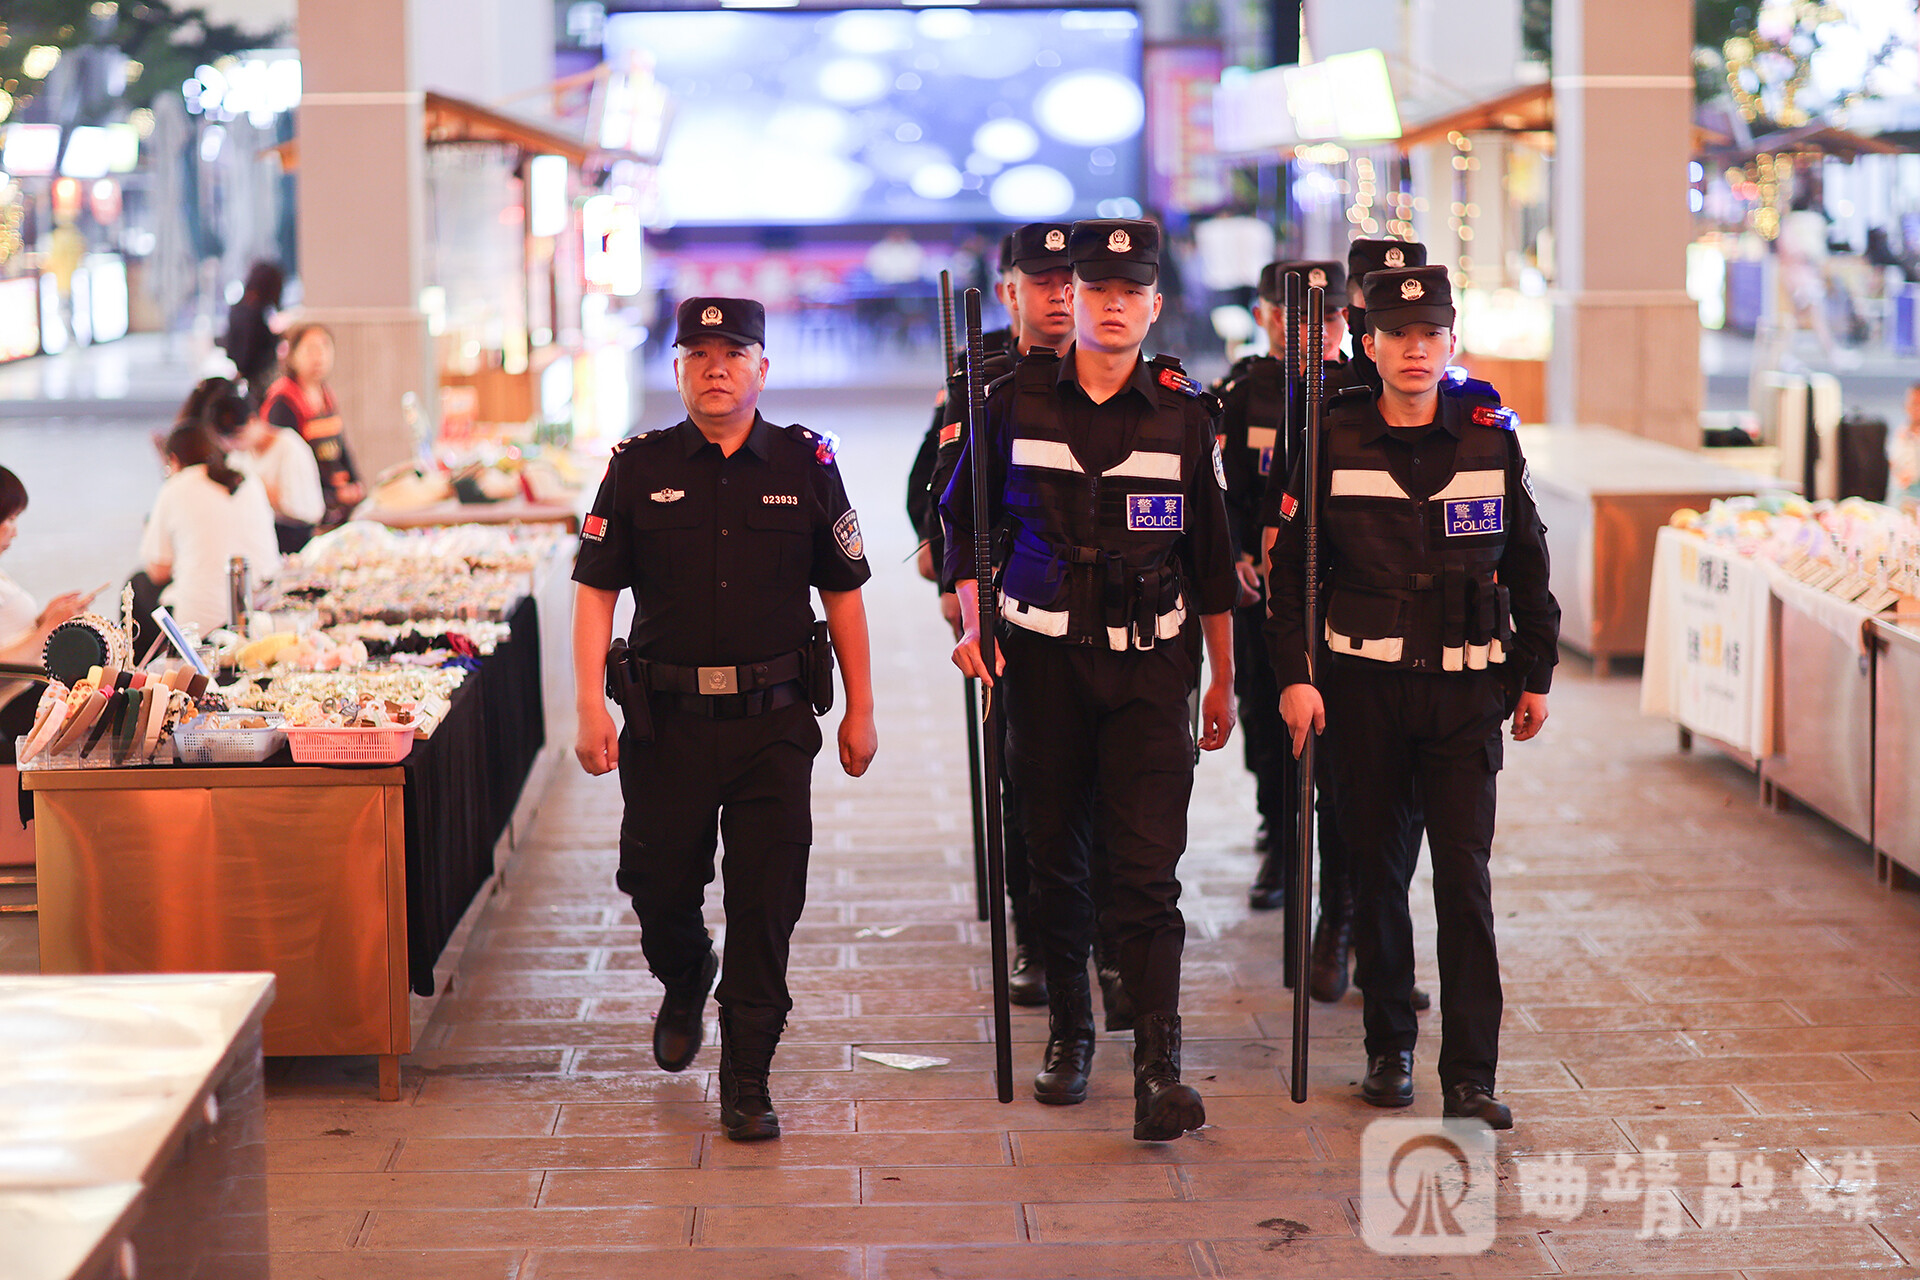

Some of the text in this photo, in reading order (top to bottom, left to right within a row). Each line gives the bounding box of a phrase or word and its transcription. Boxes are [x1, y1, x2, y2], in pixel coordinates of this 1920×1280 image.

[762, 495, 798, 505] 023933
[1137, 499, 1177, 513] 警察
[1454, 502, 1496, 519] 警察
[1135, 515, 1178, 527] POLICE
[1453, 518, 1498, 532] POLICE
